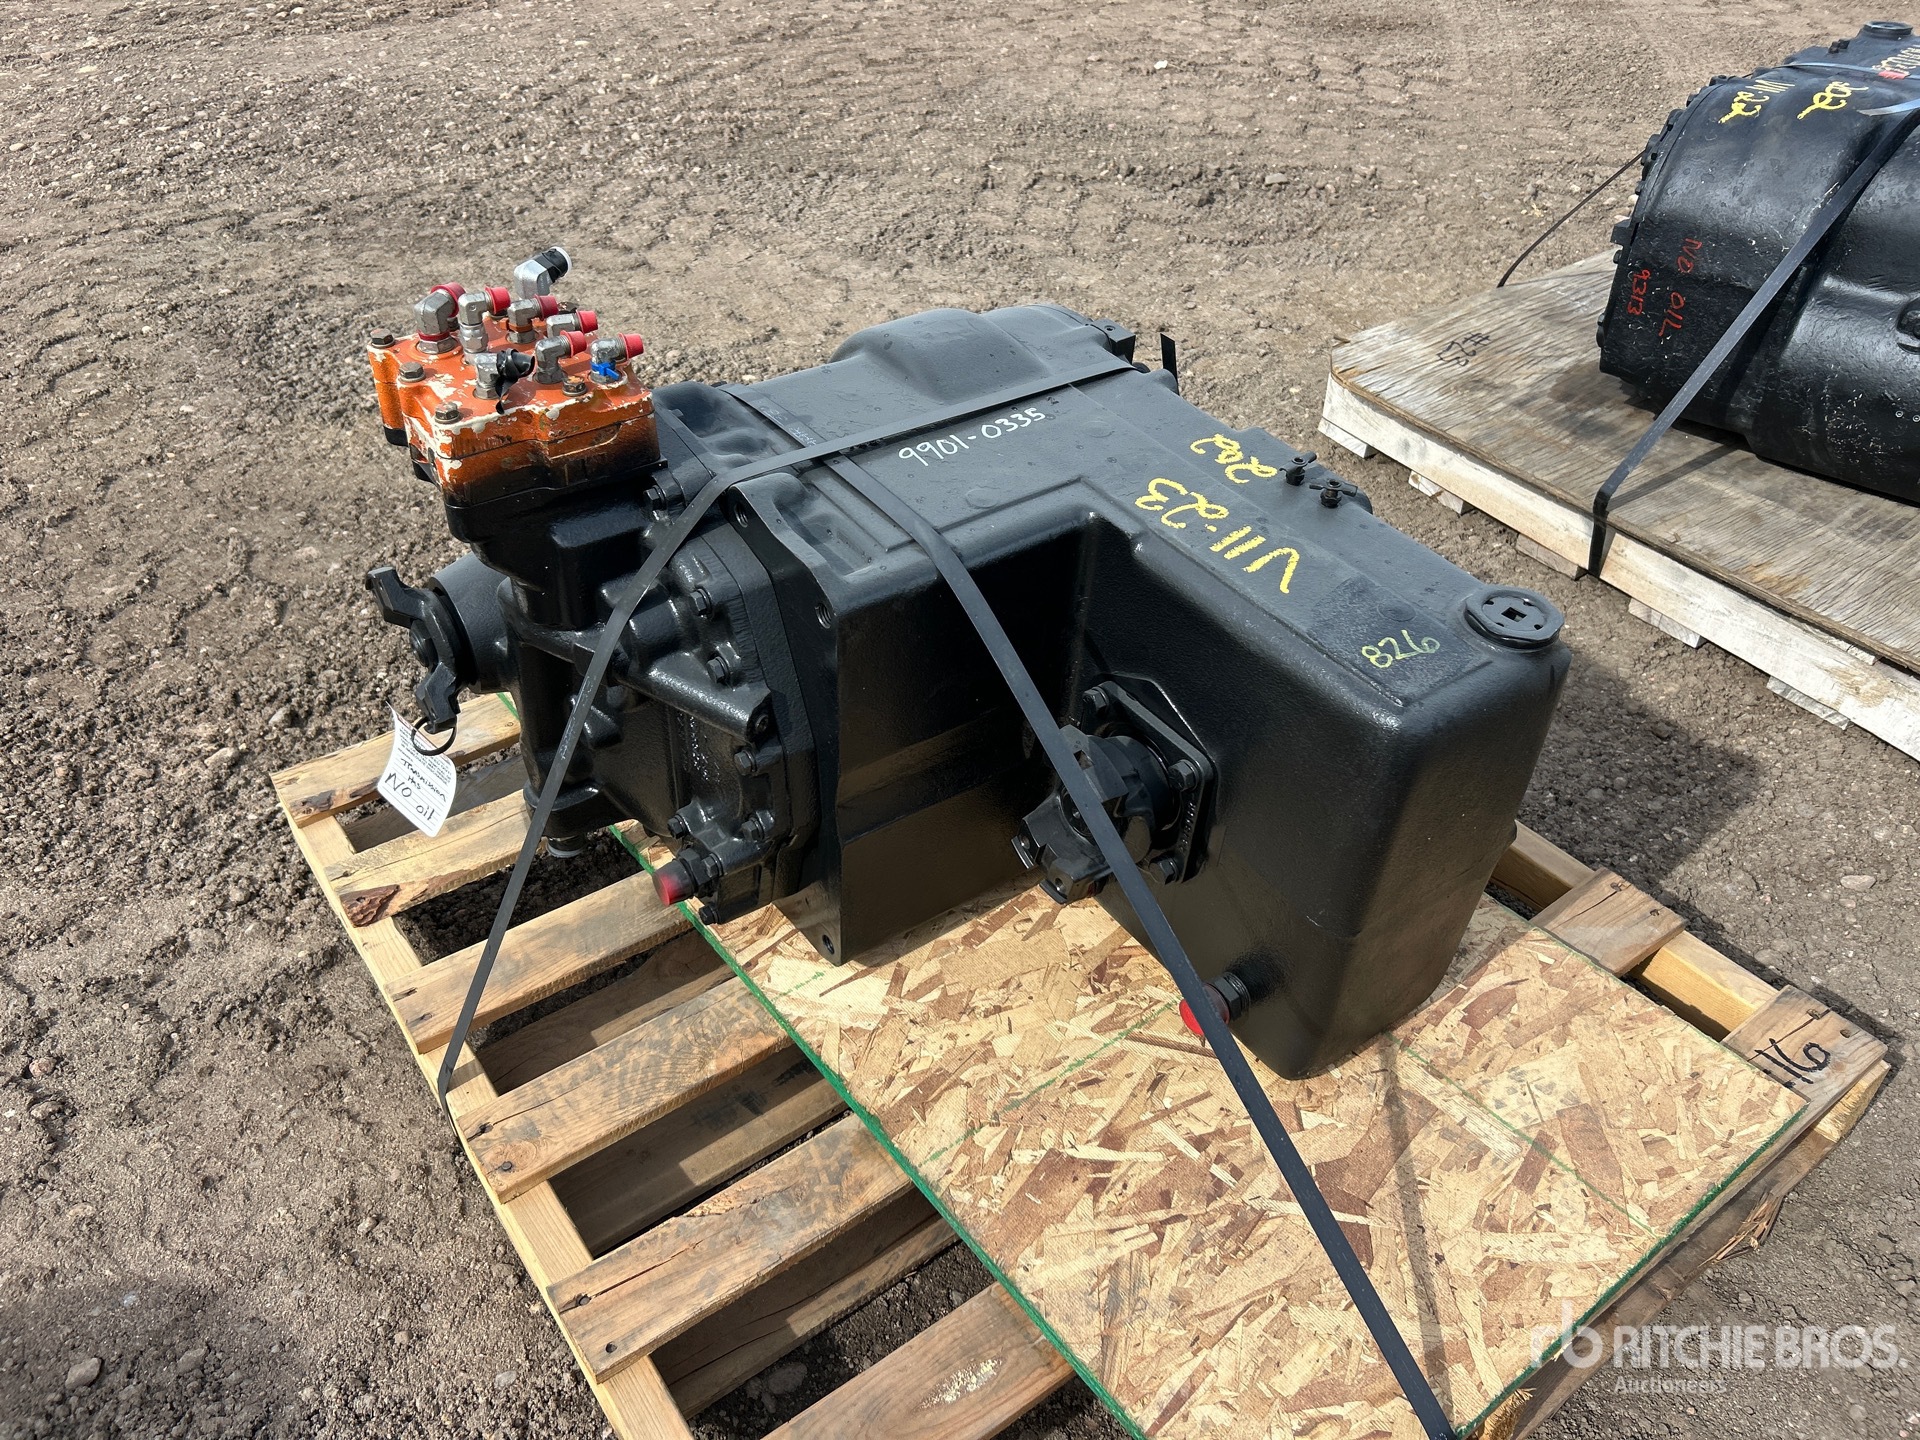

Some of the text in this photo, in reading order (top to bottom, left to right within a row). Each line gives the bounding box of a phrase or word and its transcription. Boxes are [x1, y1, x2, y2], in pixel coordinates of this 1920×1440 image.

[1627, 269, 1651, 316] 9313
[1658, 238, 1703, 338] NO OIL
[898, 407, 1046, 467] 9901-0335
[1361, 629, 1441, 669] 826
